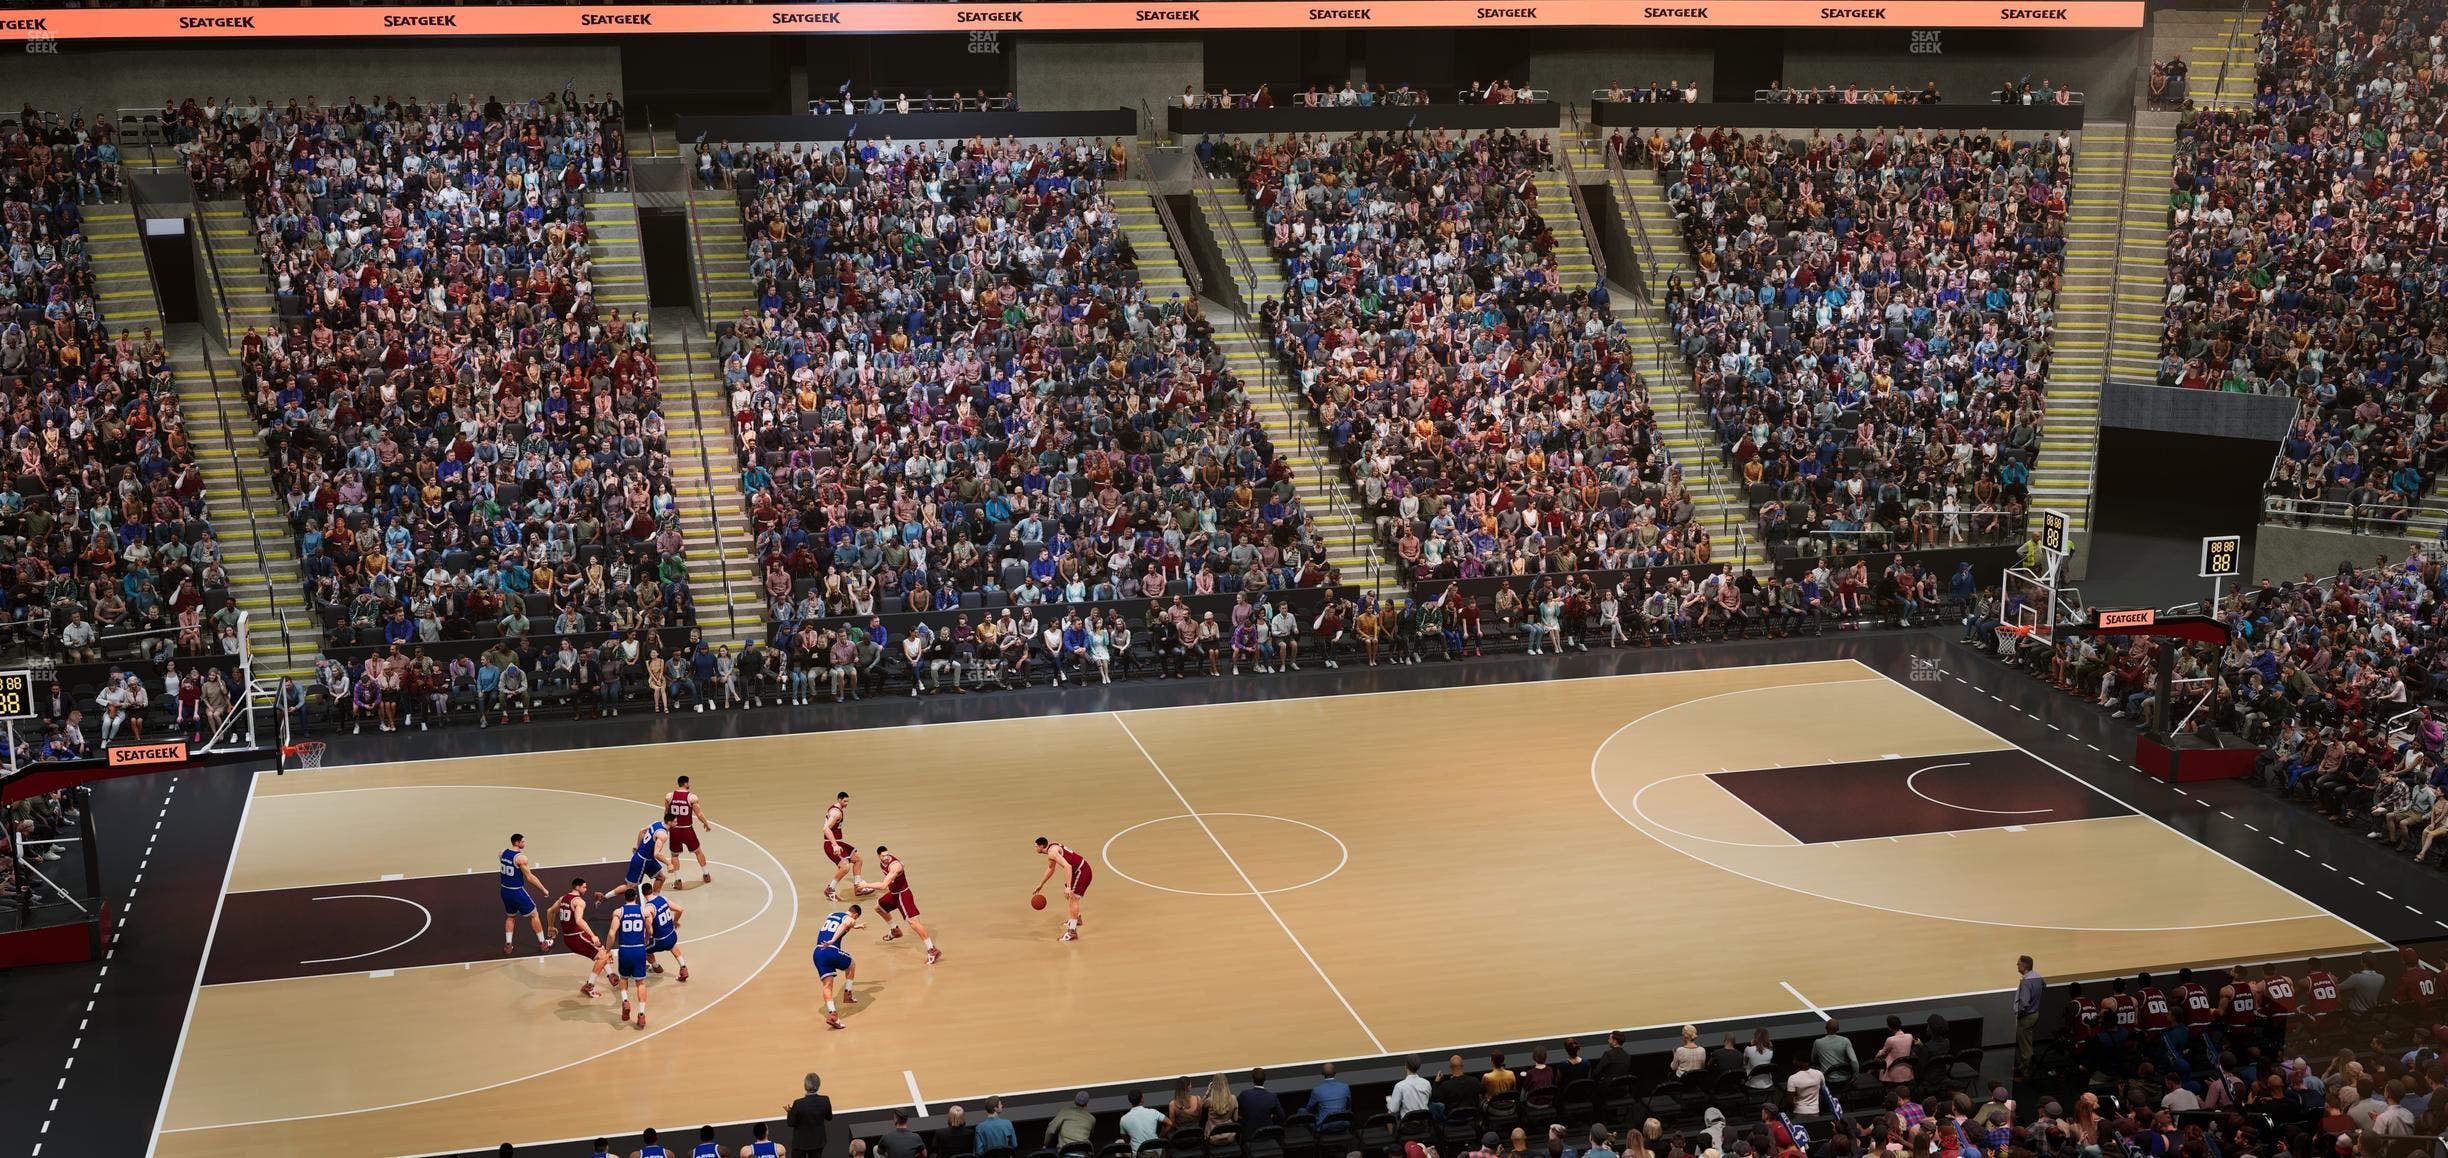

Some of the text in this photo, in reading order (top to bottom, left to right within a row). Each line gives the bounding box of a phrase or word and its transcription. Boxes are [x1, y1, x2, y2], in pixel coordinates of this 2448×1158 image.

[773, 13, 840, 24] SEATGEEK
[958, 12, 1023, 22] SEATGEEK
[1137, 10, 1199, 21] SEATGEEK
[1310, 9, 1370, 20] SEATGEEK
[1478, 8, 1536, 18] SEATGEEK
[1645, 8, 1707, 18] SEATGEEK
[1821, 8, 1886, 19] SEATGEEK
[2001, 9, 2066, 19] SEATGEEK
[180, 17, 254, 29] SEATGEEK
[384, 15, 456, 27] SEATGEEK
[582, 14, 651, 25] SEATGEEK
[2047, 528, 2059, 549] 88
[2211, 541, 2235, 553] 88 88
[2212, 553, 2231, 572] 88
[2106, 612, 2148, 625] SEATGEEK
[6, 676, 22, 690] 88
[116, 746, 179, 762] SEATGEEK
[670, 804, 689, 816] 00
[622, 919, 643, 932] 00
[820, 919, 840, 933] 00
[2268, 983, 2293, 999] 00
[2313, 986, 2336, 1000] 00
[2147, 1000, 2168, 1014] 00
[2189, 996, 2210, 1009] 00
[2233, 998, 2254, 1012] 00
[2116, 1012, 2136, 1025] 00
